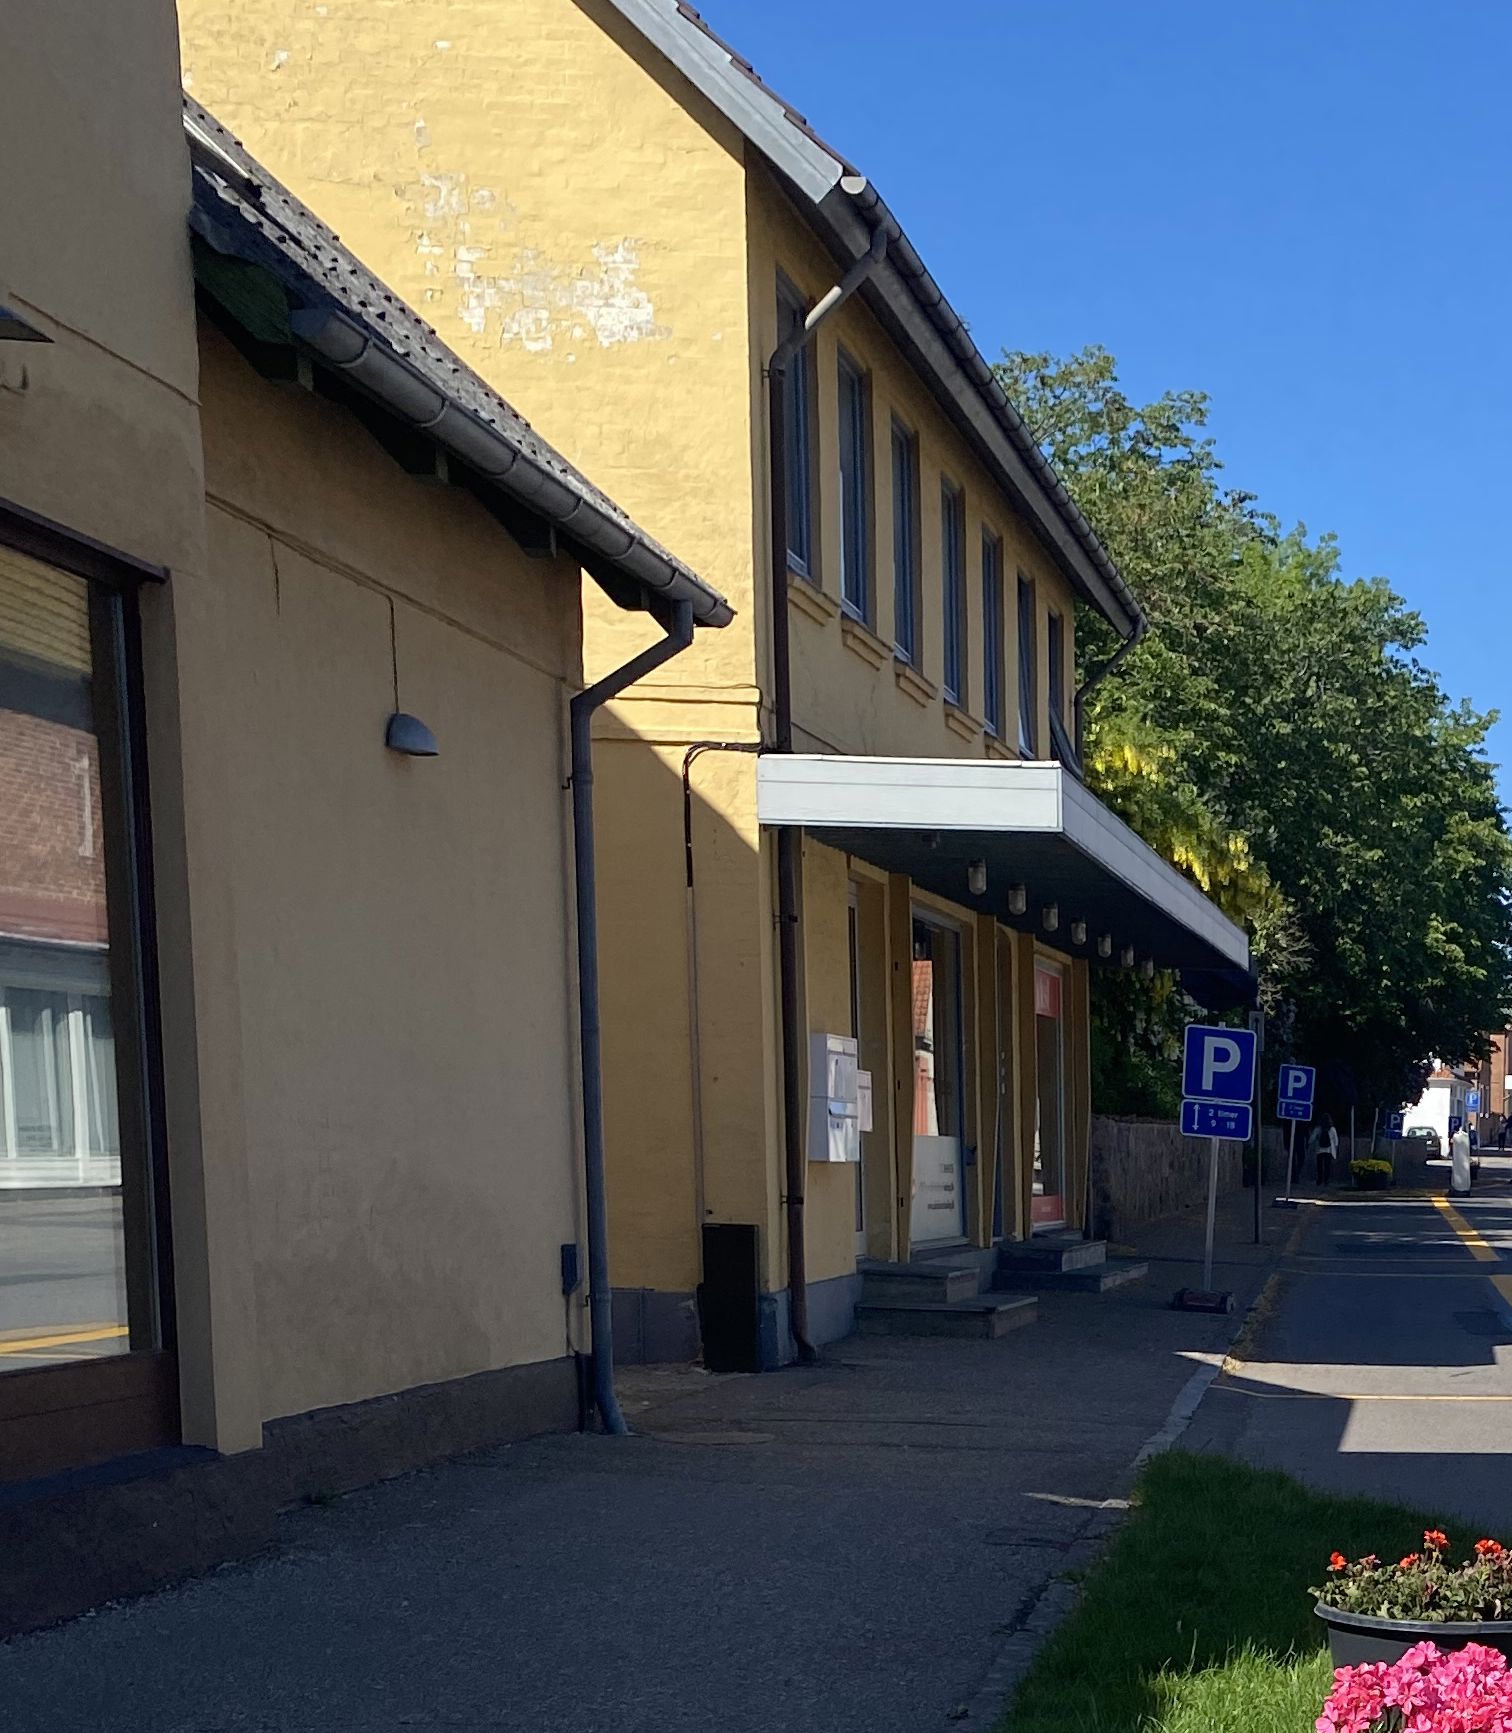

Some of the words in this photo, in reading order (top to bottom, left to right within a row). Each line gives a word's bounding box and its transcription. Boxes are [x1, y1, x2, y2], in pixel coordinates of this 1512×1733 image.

[1202, 1036, 1241, 1090] P
[1287, 1069, 1307, 1097] P
[1470, 1093, 1477, 1104] P
[1209, 1109, 1214, 1117] 2
[1391, 1114, 1400, 1129] P
[1452, 1119, 1459, 1132] P
